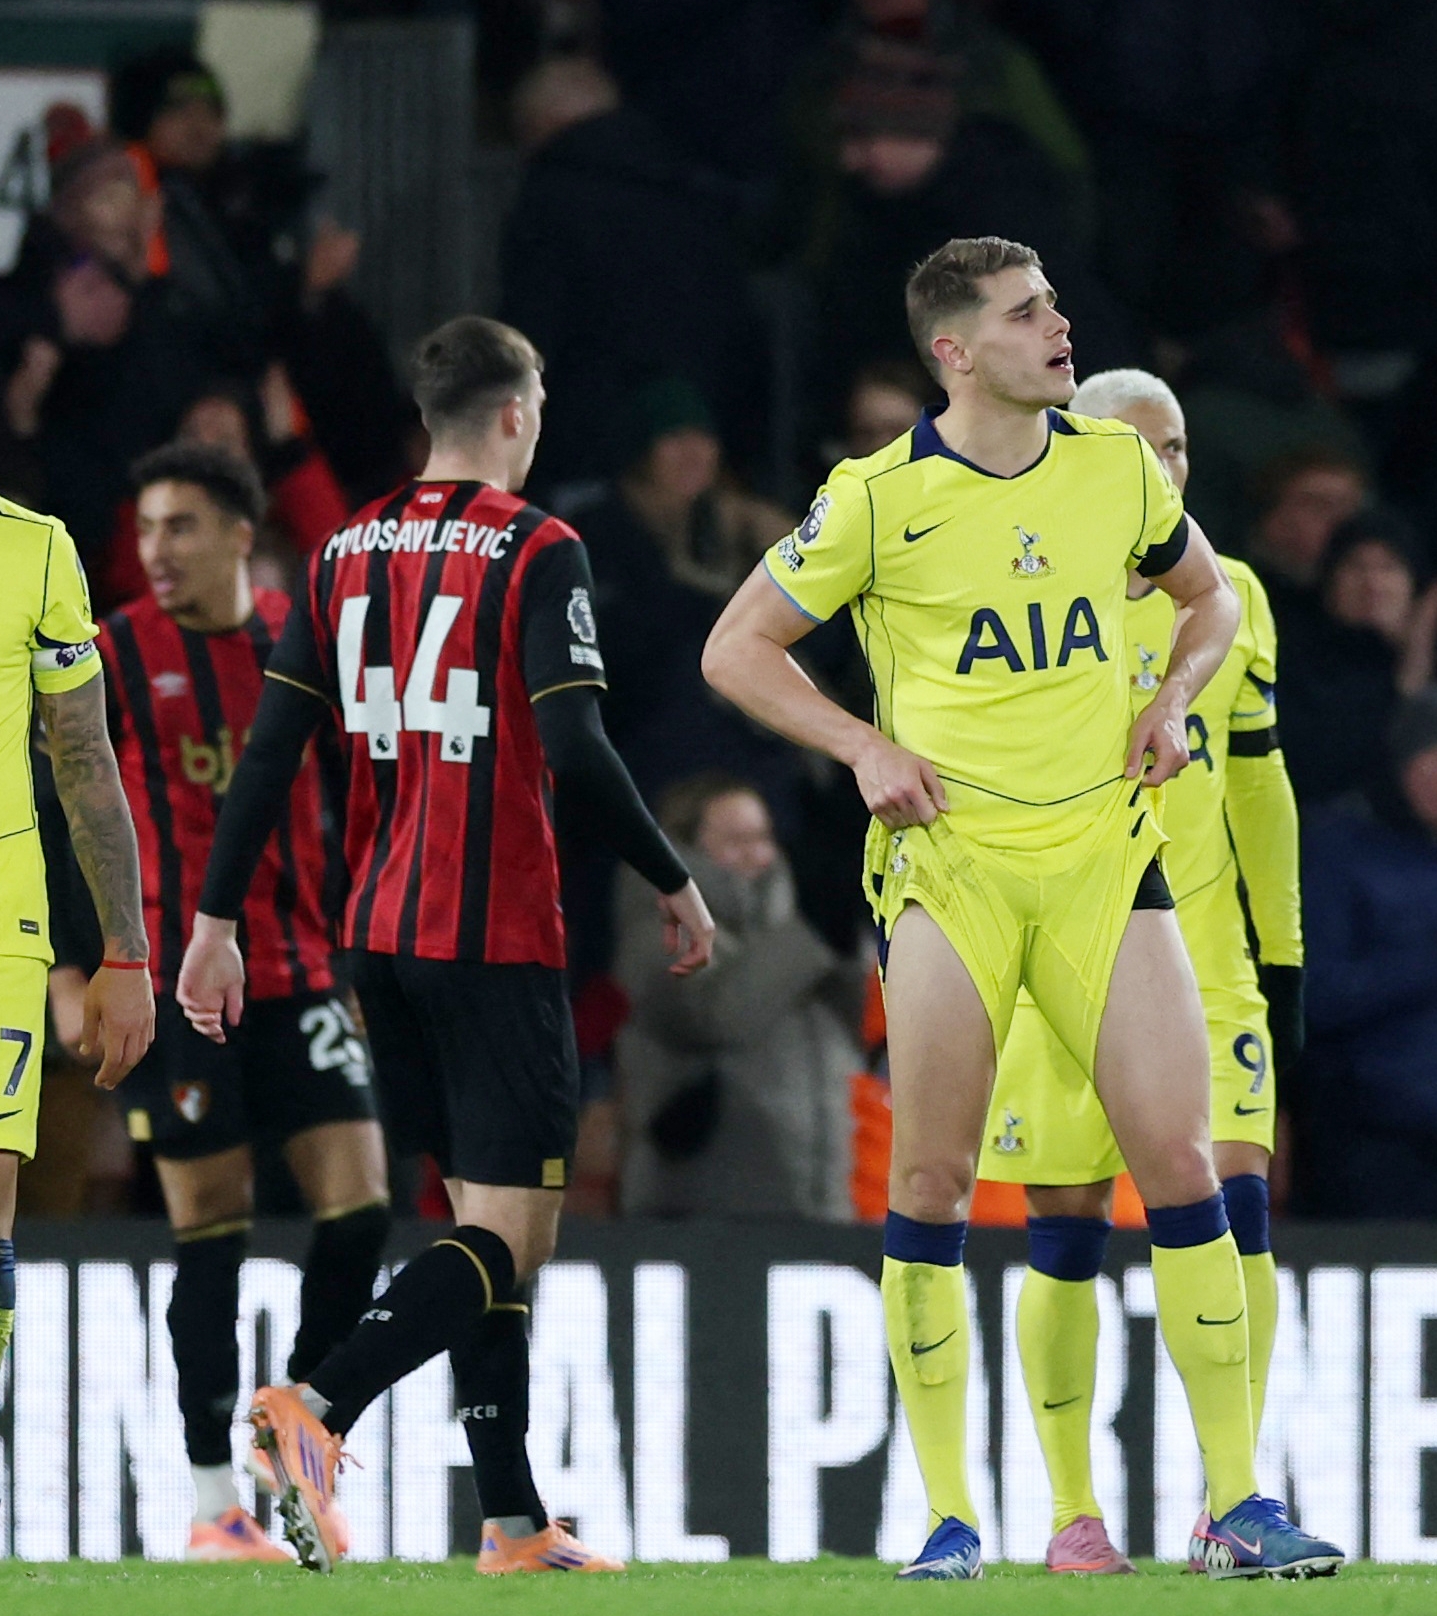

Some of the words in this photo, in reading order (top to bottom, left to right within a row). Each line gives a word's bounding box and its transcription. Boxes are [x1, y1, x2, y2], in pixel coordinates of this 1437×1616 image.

[956, 597, 1109, 675] AIA
[337, 595, 490, 763] 44
[1233, 1033, 1266, 1094] 9
